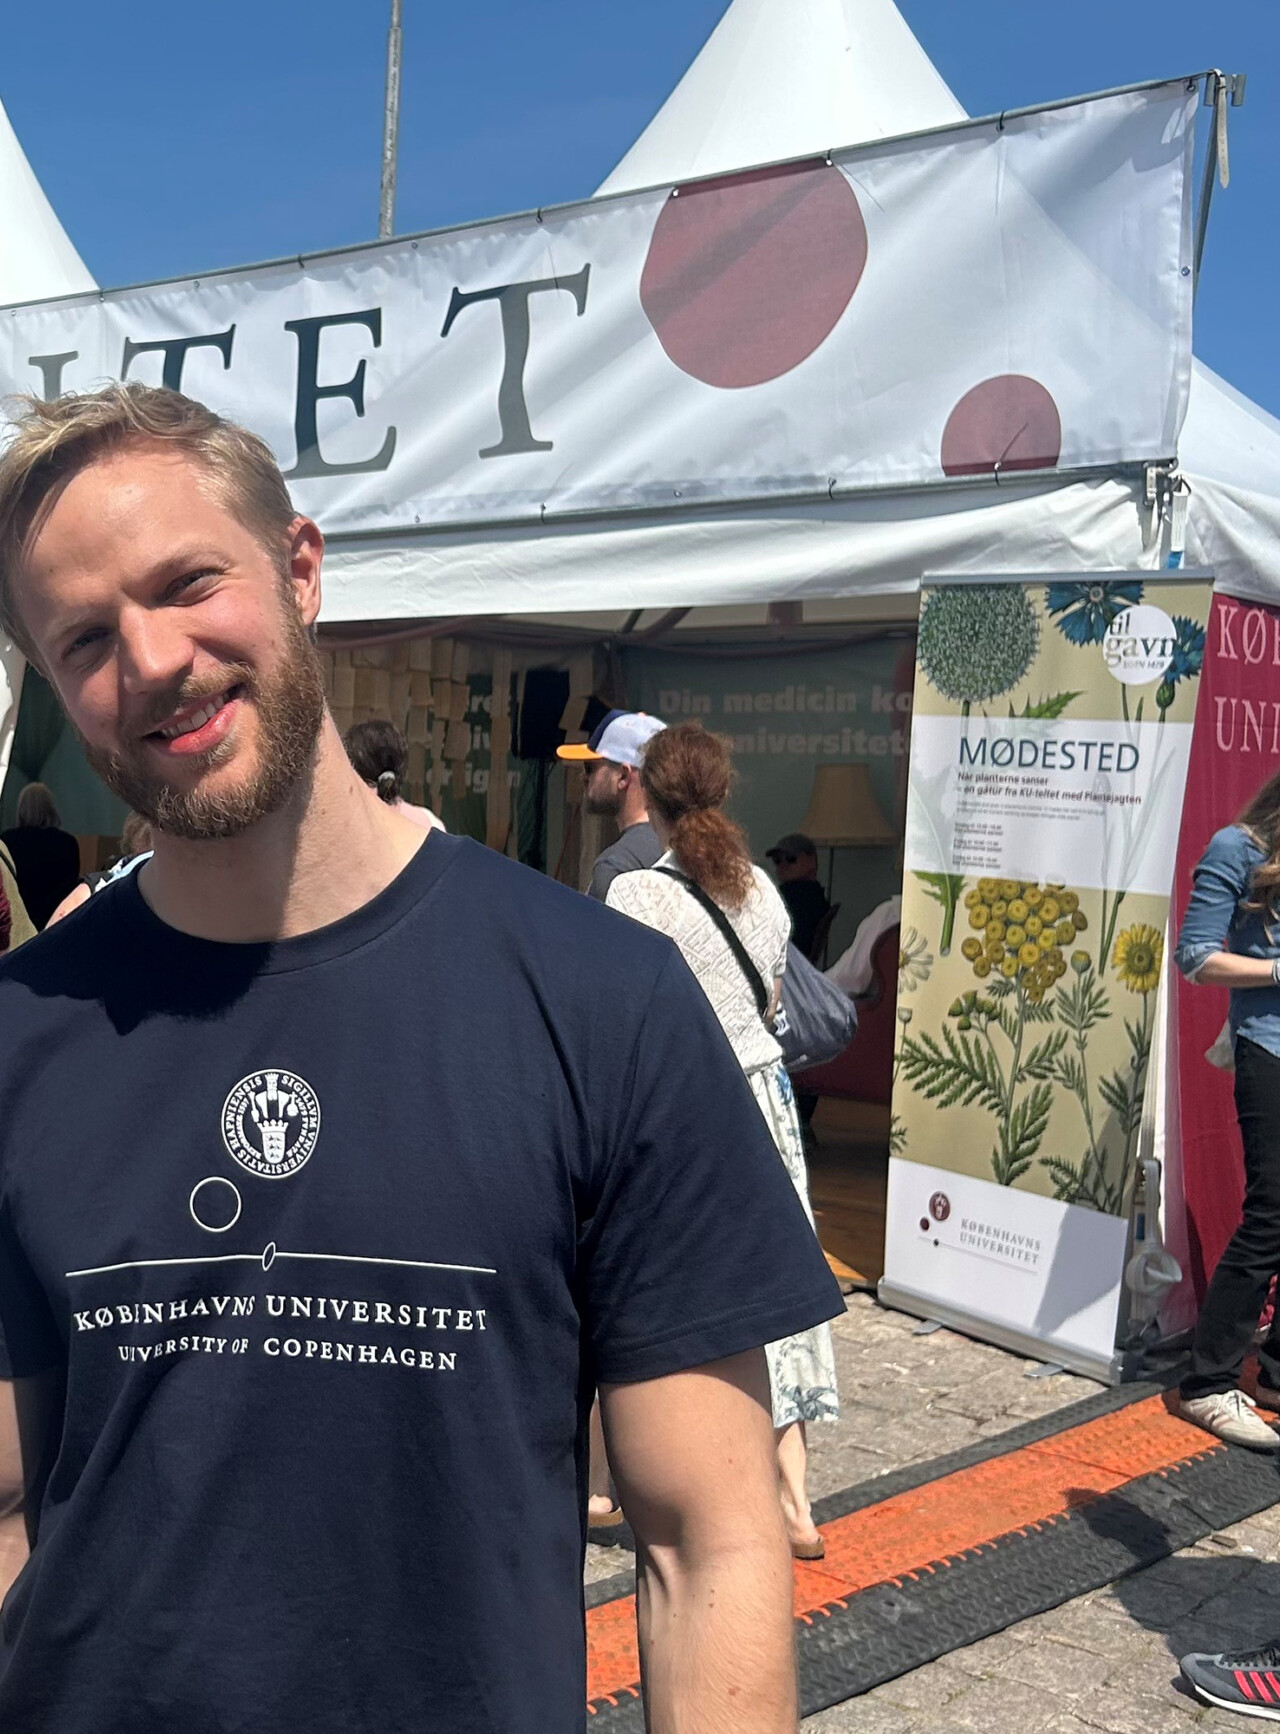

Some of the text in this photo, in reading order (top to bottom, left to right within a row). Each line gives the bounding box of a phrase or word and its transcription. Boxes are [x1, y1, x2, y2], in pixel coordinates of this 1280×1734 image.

[659, 686, 711, 714] Din
[723, 684, 857, 714] medicin
[959, 736, 1140, 773] MØDESTED
[1062, 789, 1083, 801] med
[960, 1231, 1040, 1265] UNIVERSITET
[961, 1218, 1041, 1252] KØBENHAVNS
[265, 1294, 487, 1331] UNIVERSITET
[118, 1335, 458, 1371] UIVERSITY OF COPENHAGEN
